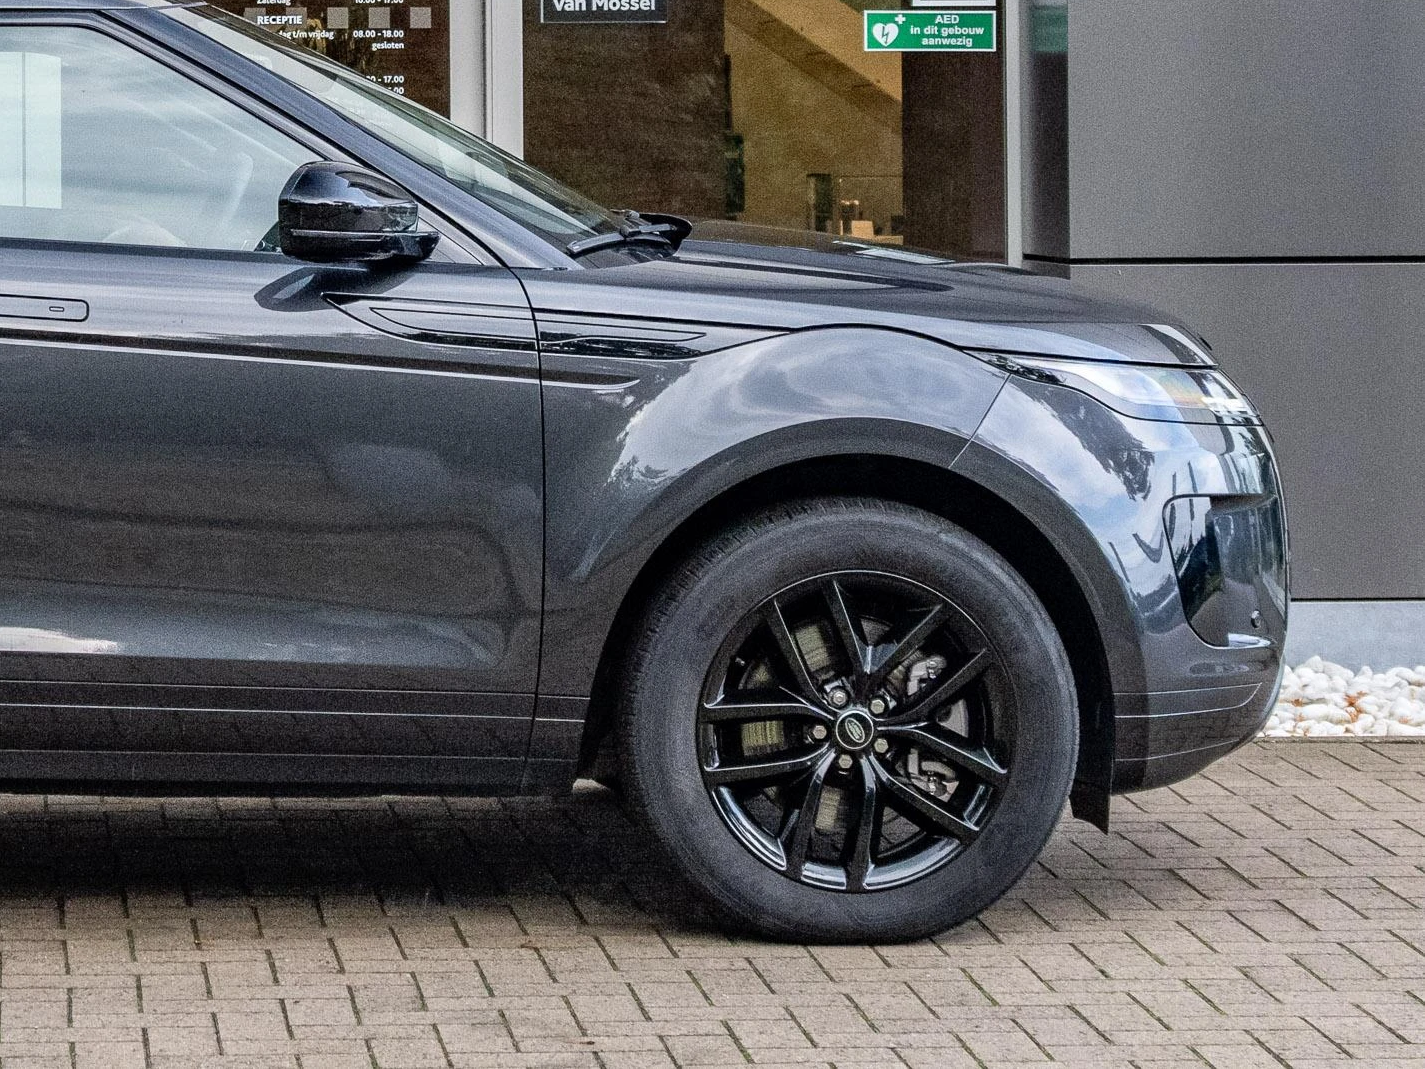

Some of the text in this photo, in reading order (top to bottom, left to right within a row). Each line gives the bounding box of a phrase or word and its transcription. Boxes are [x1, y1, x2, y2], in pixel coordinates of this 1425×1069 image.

[257, 15, 303, 25] RECEPTIE
[935, 14, 960, 24] AED
[308, 29, 335, 40] vrijdag
[353, 29, 376, 38] 08.00
[382, 29, 405, 38] 18.00
[910, 25, 985, 37] in dit gebouw
[371, 41, 405, 52] gesloten
[921, 36, 973, 47] aanwezig
[383, 75, 405, 83] 17.00
